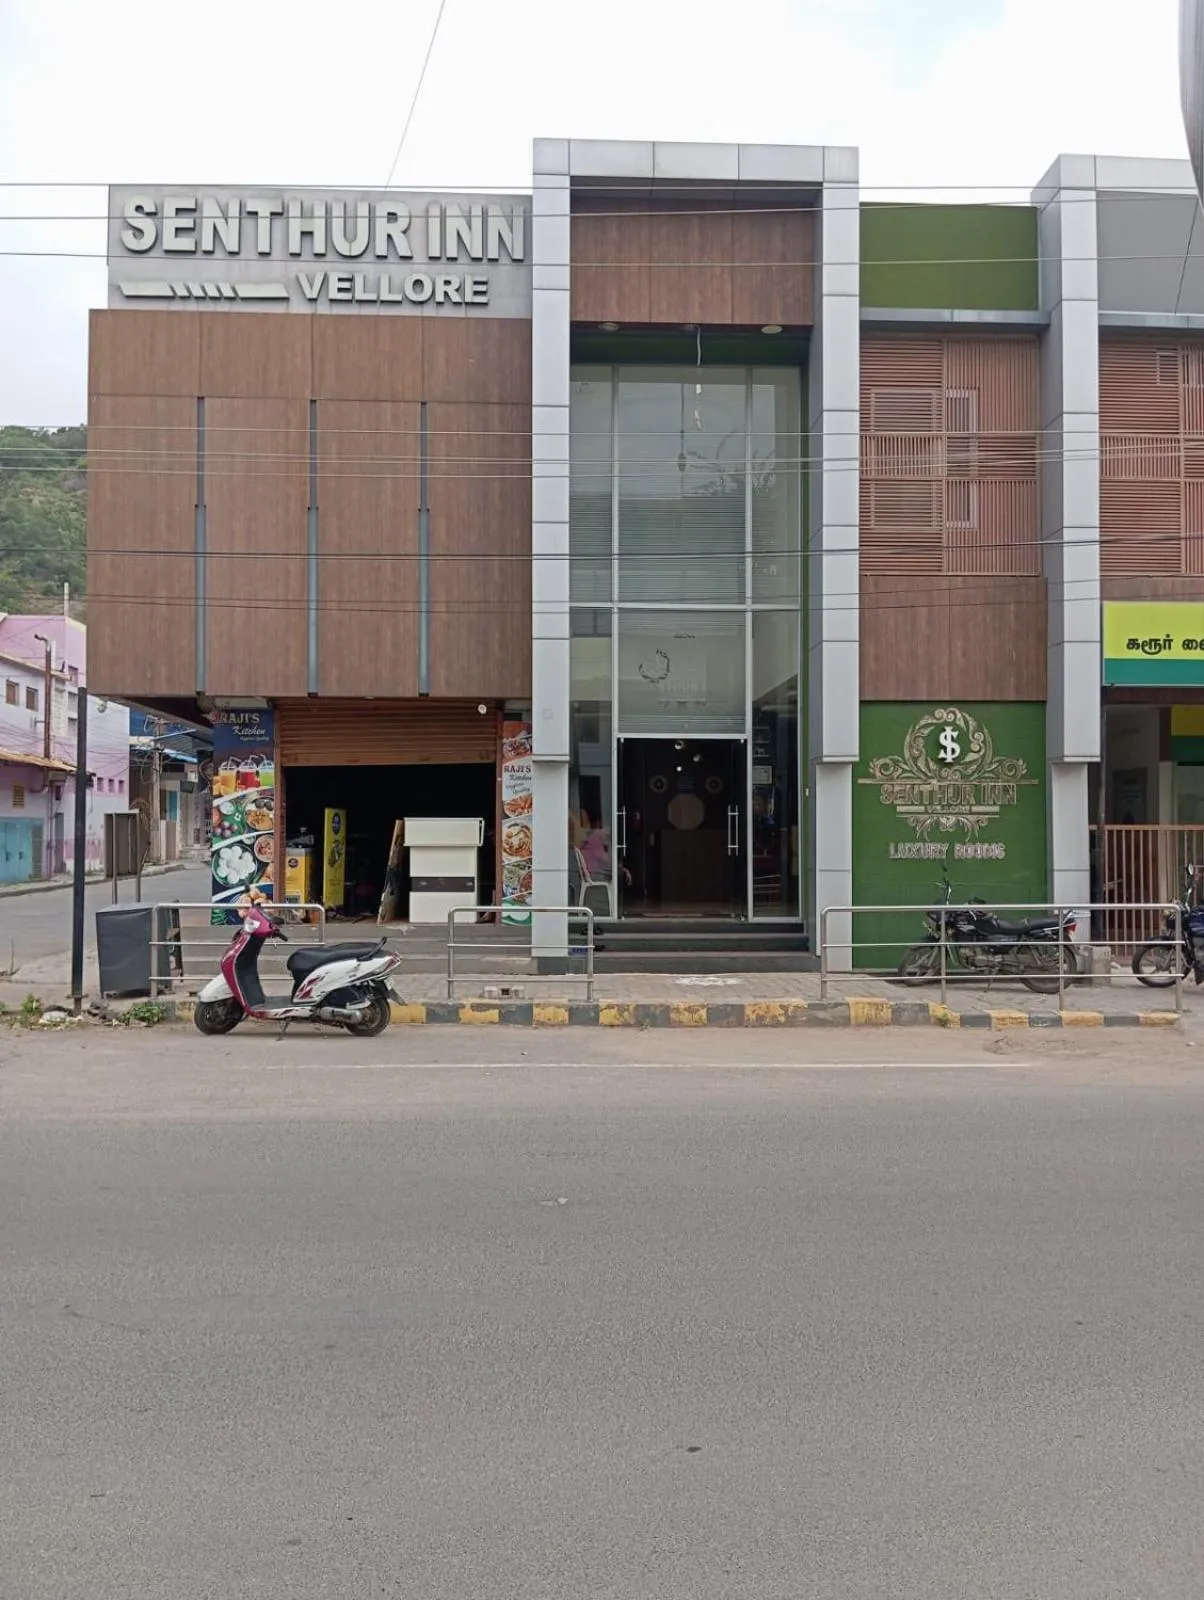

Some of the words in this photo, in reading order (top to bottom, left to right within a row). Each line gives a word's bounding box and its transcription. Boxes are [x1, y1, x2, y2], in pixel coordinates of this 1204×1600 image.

[120, 194, 413, 259] SENTHUR
[427, 202, 525, 261] INN
[296, 272, 489, 304] VELLORE
[1126, 634, 1173, 655] கரூர்
[232, 725, 266, 736] Kitchen
[504, 765, 532, 773] RAJI'S
[880, 783, 976, 805] SENTHUR
[980, 783, 1017, 805] INN
[889, 842, 949, 859] LUXURY
[954, 842, 1006, 859] ROOMS
